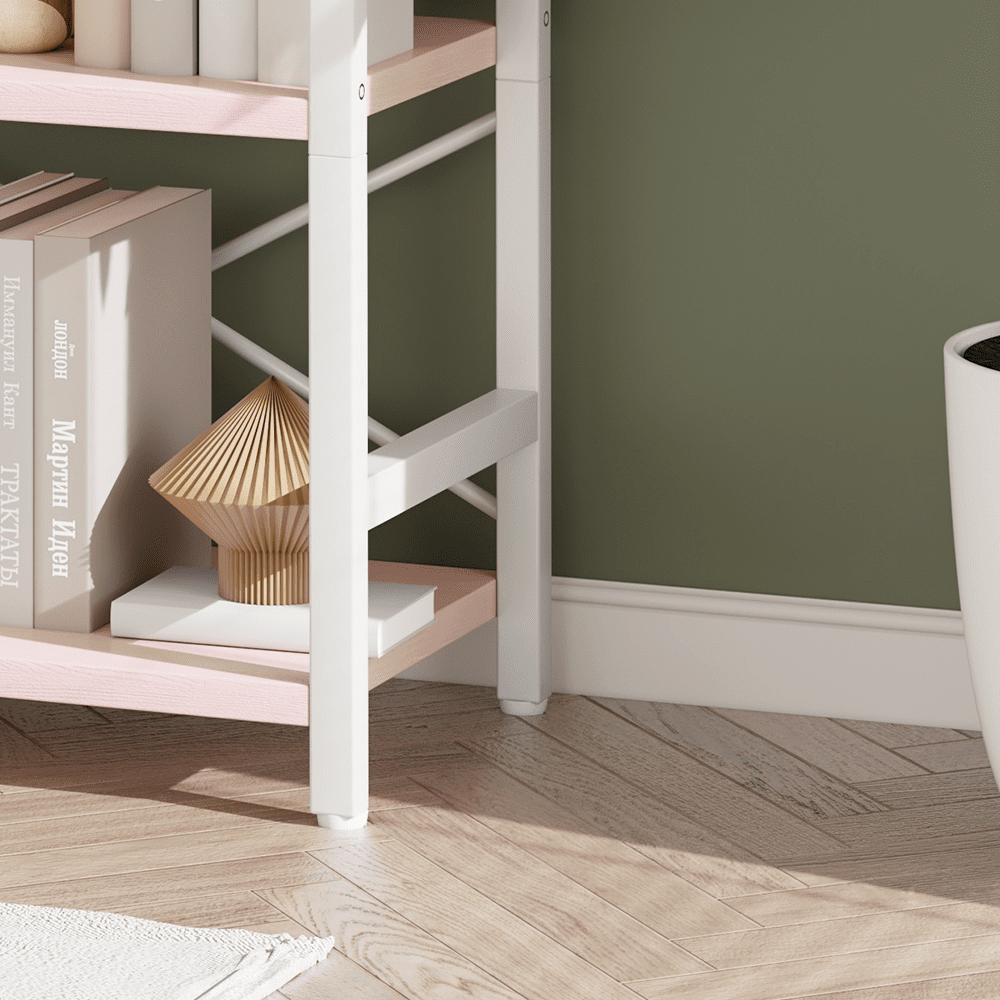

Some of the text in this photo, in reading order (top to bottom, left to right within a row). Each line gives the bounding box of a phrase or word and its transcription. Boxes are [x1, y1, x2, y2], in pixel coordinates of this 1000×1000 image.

[0, 275, 21, 429] Иммануил Кант
[0, 462, 20, 588] ТРАКТАТЫ
[46, 418, 76, 578] Мартин Иден
